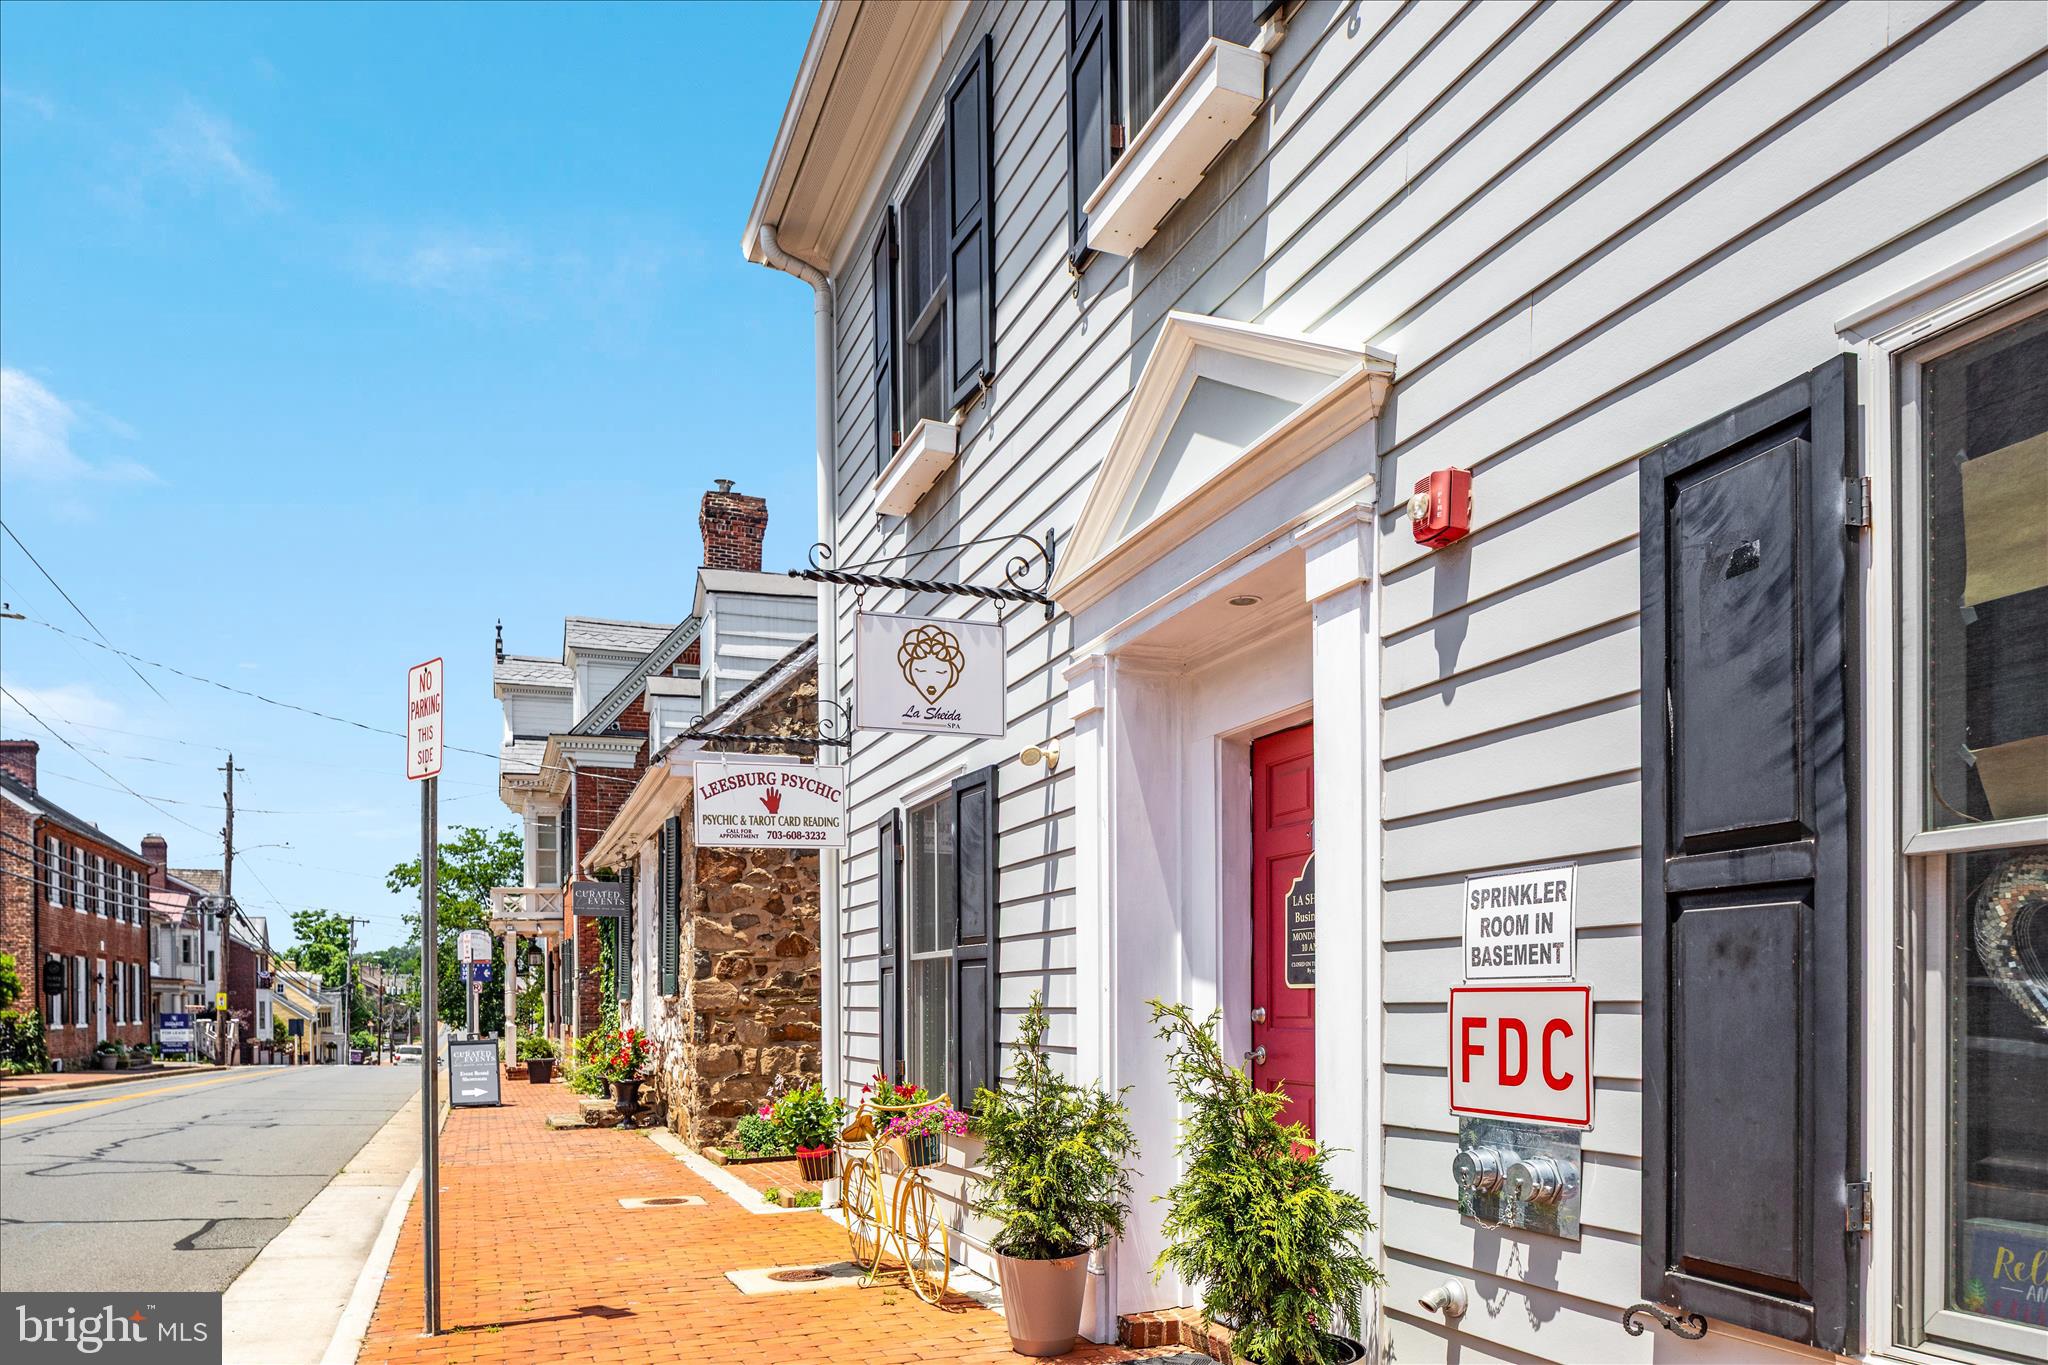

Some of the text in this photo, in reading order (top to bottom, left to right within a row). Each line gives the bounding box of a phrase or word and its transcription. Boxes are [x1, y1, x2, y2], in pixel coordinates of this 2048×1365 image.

[419, 671, 432, 693] NO
[411, 693, 440, 720] PARKING
[902, 705, 961, 721] La Sheida
[418, 725, 434, 742] THIS
[417, 747, 434, 765] SIDE
[699, 771, 842, 803] LEESBURG PSYCHIC
[702, 814, 840, 828] PSYCHIC & TAROT CARD READING
[767, 830, 826, 841] 703-608-3232
[575, 889, 620, 899] CURATED
[588, 897, 625, 906] EVENTS
[1293, 895, 1304, 906] LA
[1470, 880, 1567, 910] SPRINKLER
[1480, 912, 1553, 938] ROOM IN
[1471, 942, 1564, 967] BASEMENT
[453, 1050, 491, 1058] CURATED
[1461, 1016, 1574, 1091] FDC
[1992, 1246, 2048, 1286] Rel
